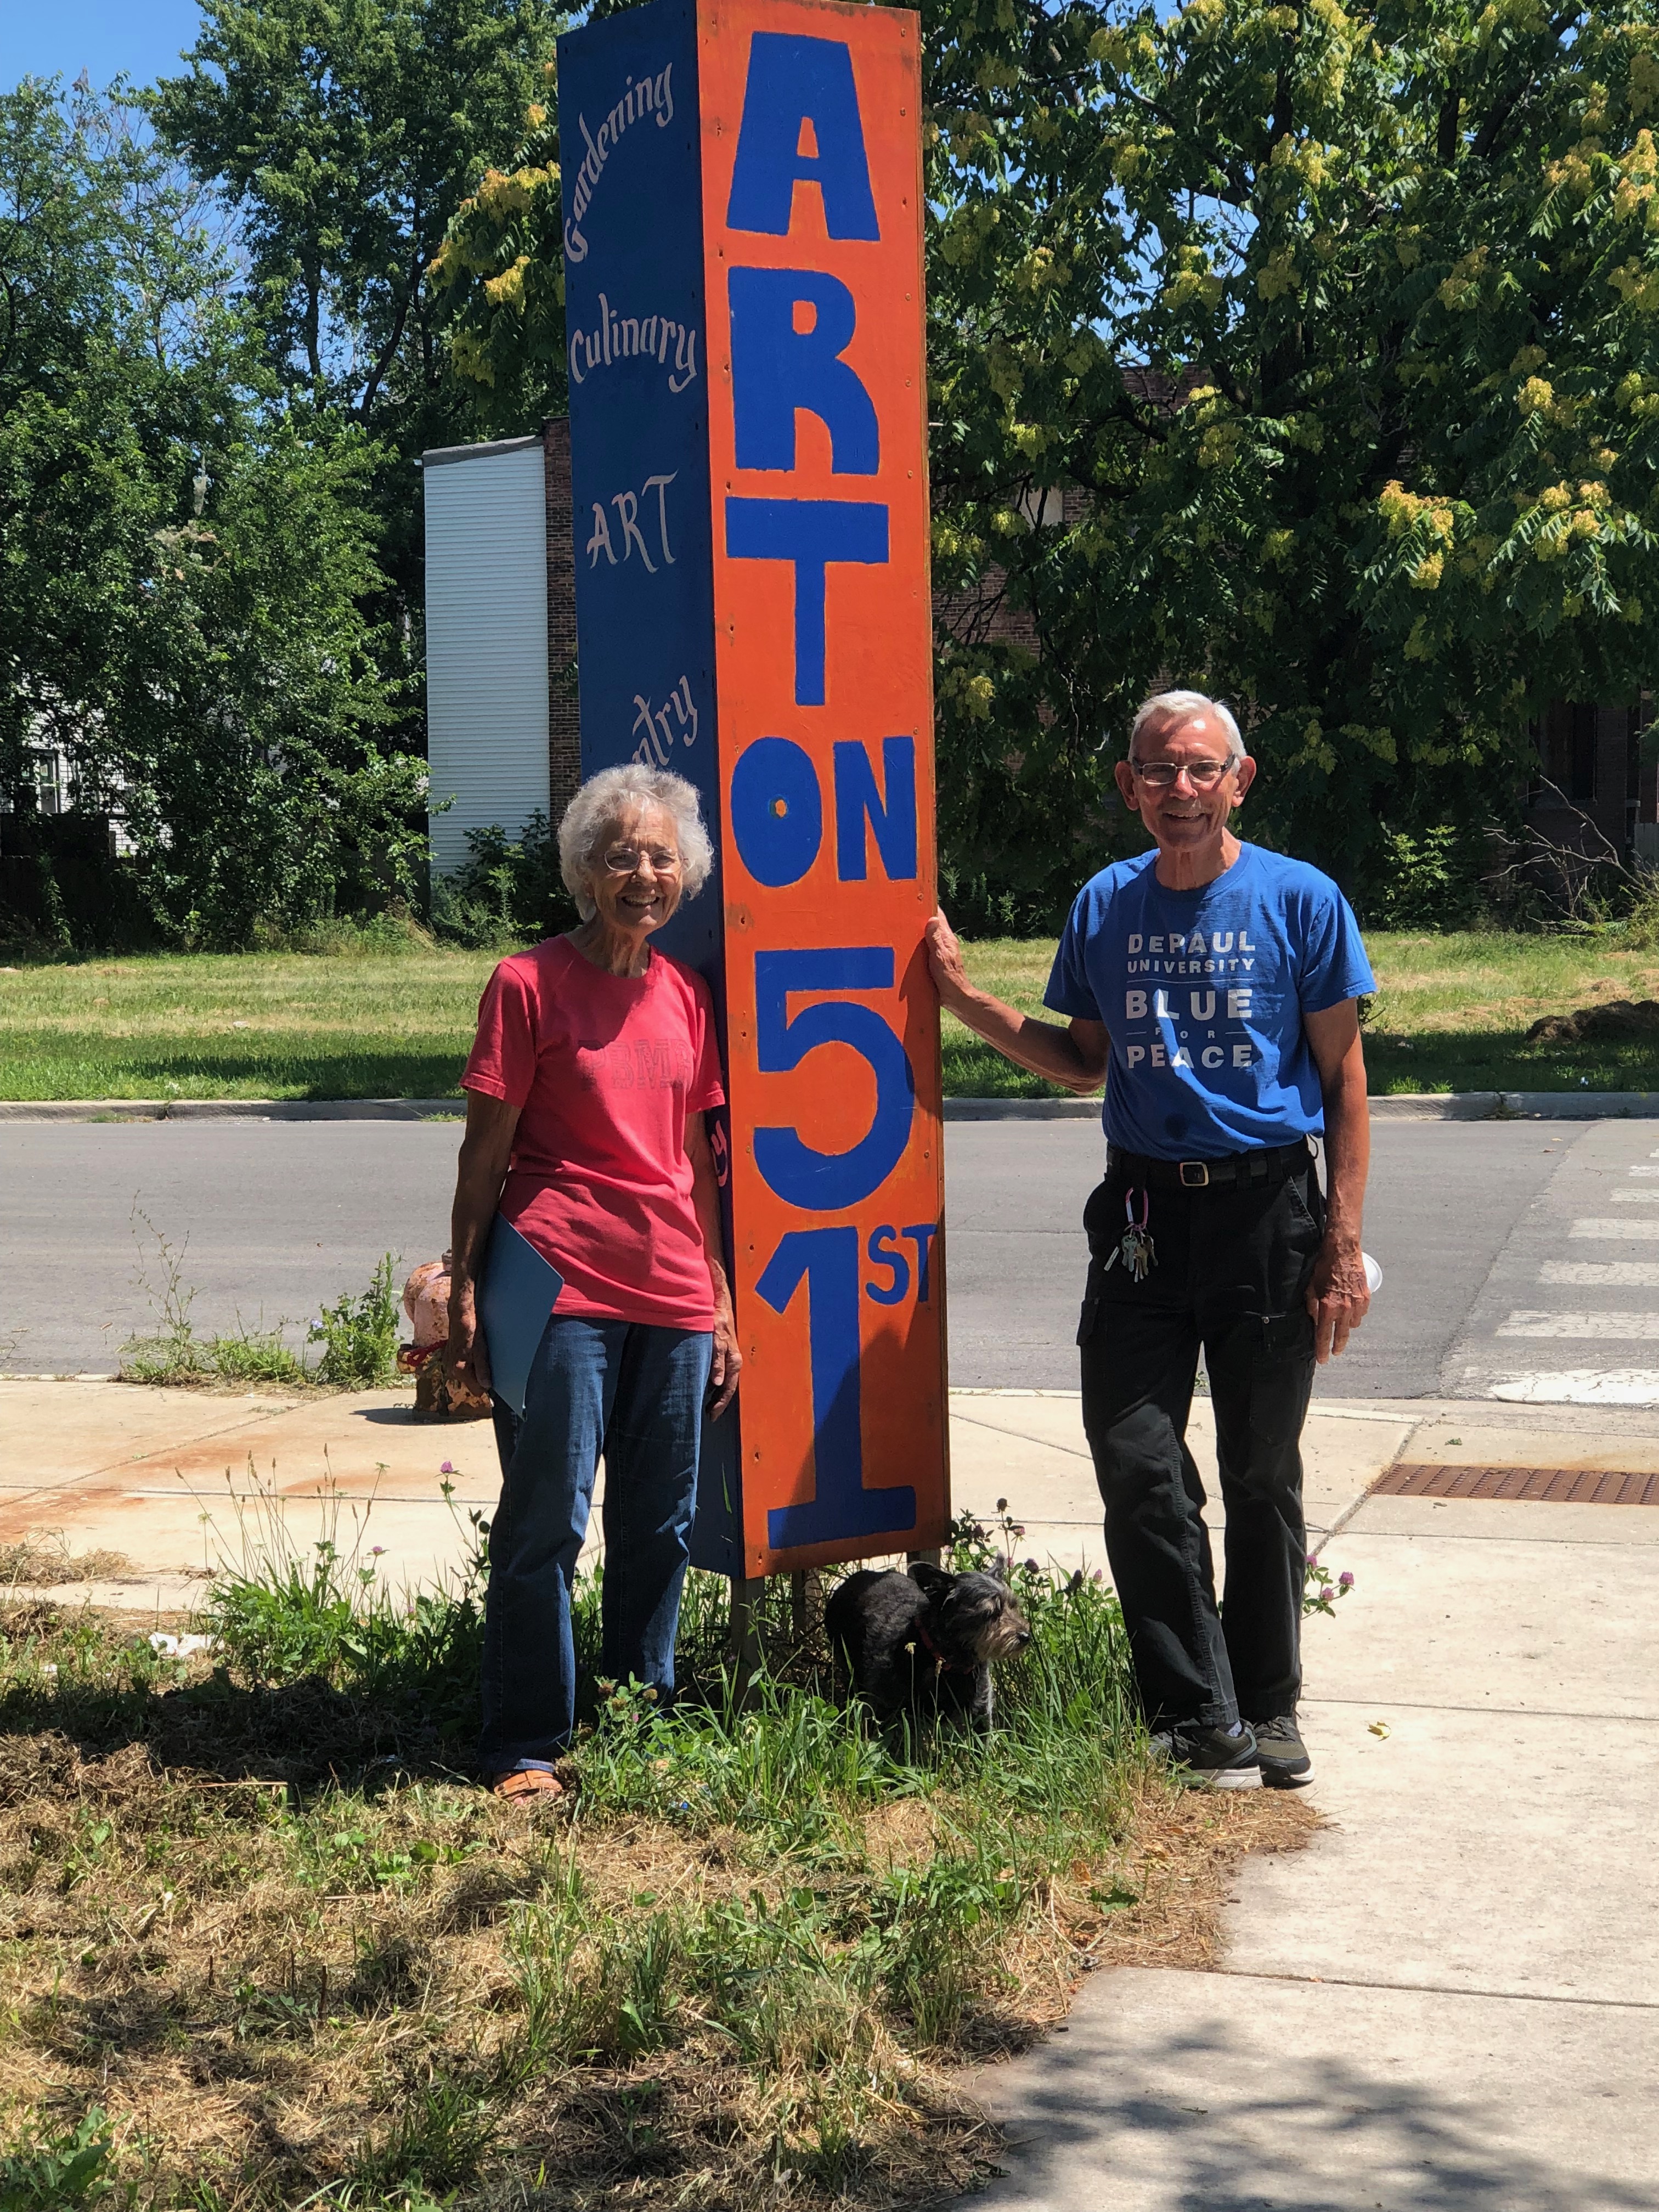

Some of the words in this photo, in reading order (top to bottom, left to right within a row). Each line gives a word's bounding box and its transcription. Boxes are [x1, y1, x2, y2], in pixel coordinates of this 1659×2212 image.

[564, 62, 673, 262] Gardening
[571, 293, 697, 392] Culinary
[726, 31, 889, 706] ART
[586, 469, 679, 573] ART
[731, 736, 917, 888] ON
[1127, 958, 1255, 973] UNIVERSITY
[1128, 932, 1255, 953] DEPAUL
[1126, 989, 1252, 1020] BLUE
[1155, 1028, 1215, 1039] FOR
[1127, 1044, 1252, 1069] PEACE
